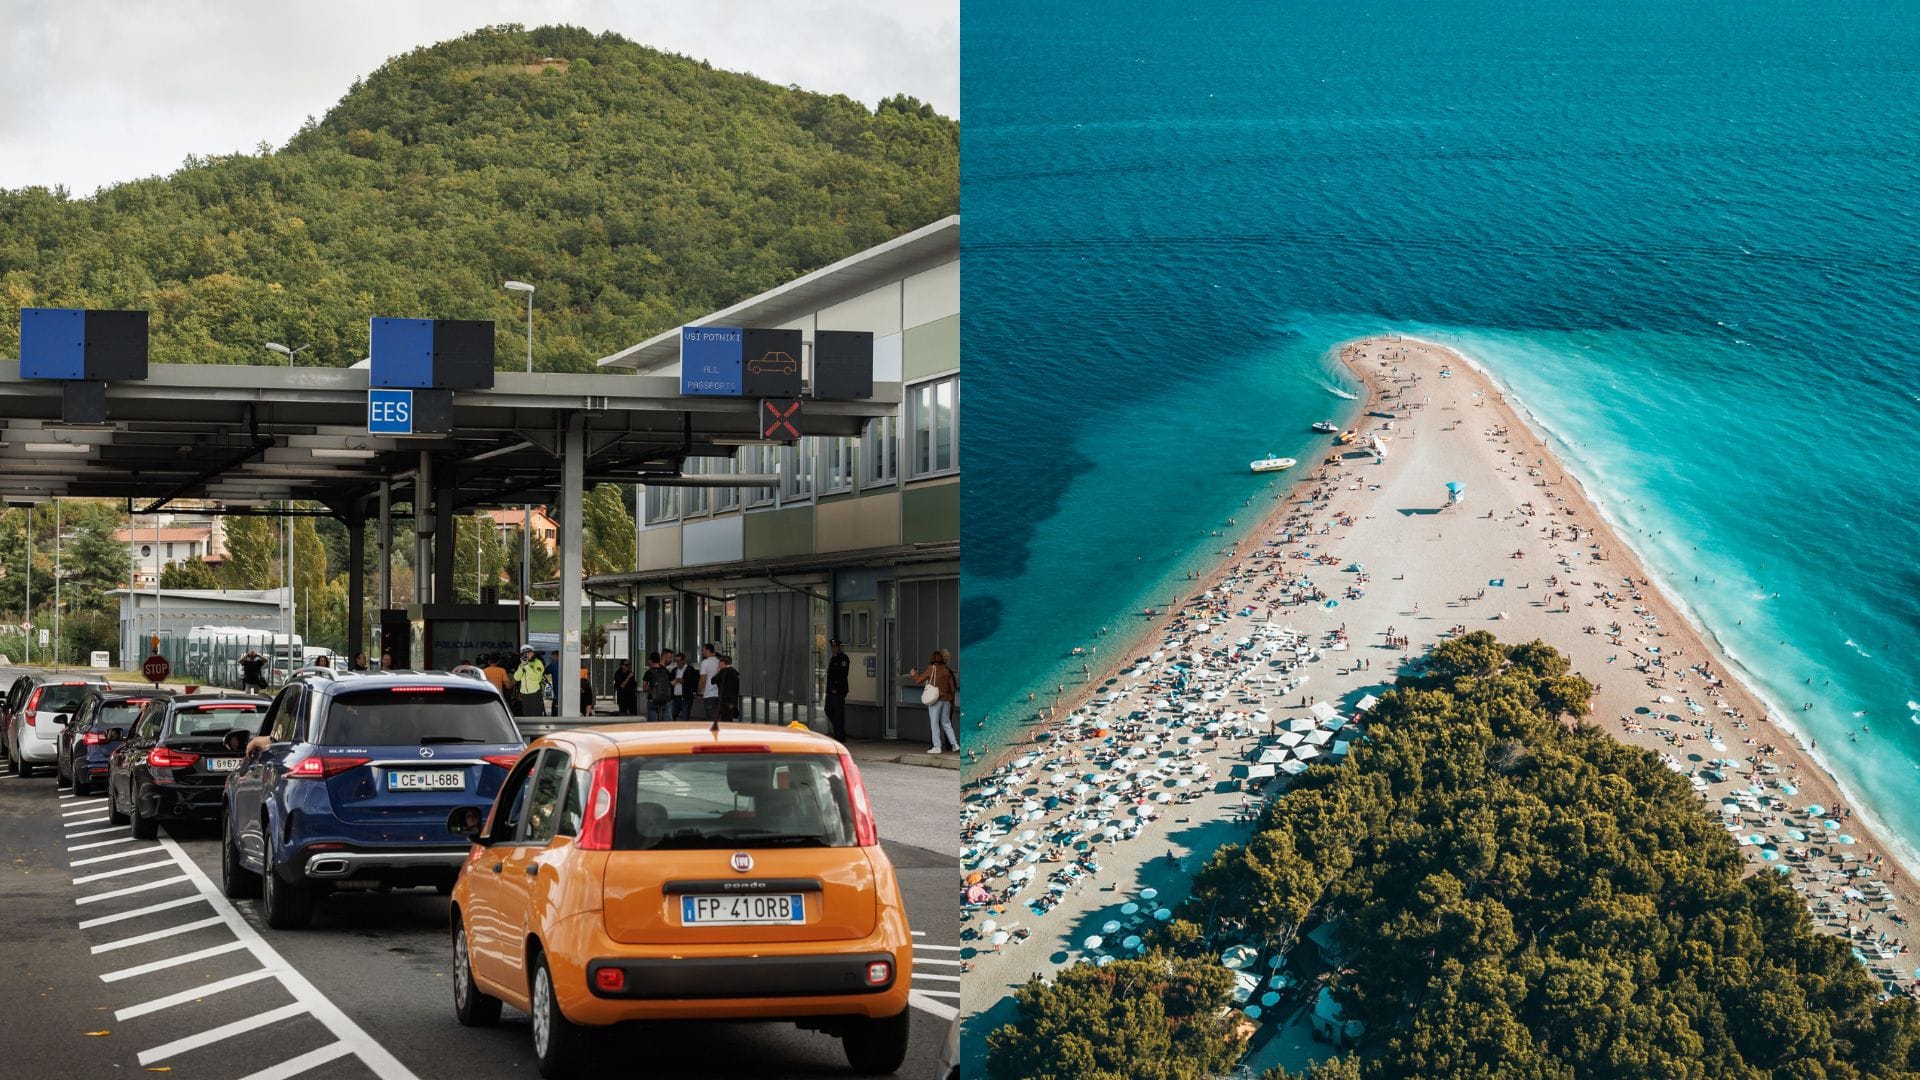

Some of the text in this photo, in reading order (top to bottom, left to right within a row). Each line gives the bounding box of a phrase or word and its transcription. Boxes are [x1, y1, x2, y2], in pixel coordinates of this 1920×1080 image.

[703, 334, 740, 342] POTNIKI
[703, 366, 719, 374] ALL
[687, 381, 736, 390] PASSPORTS
[372, 401, 409, 422] EES
[145, 663, 168, 675] STOP
